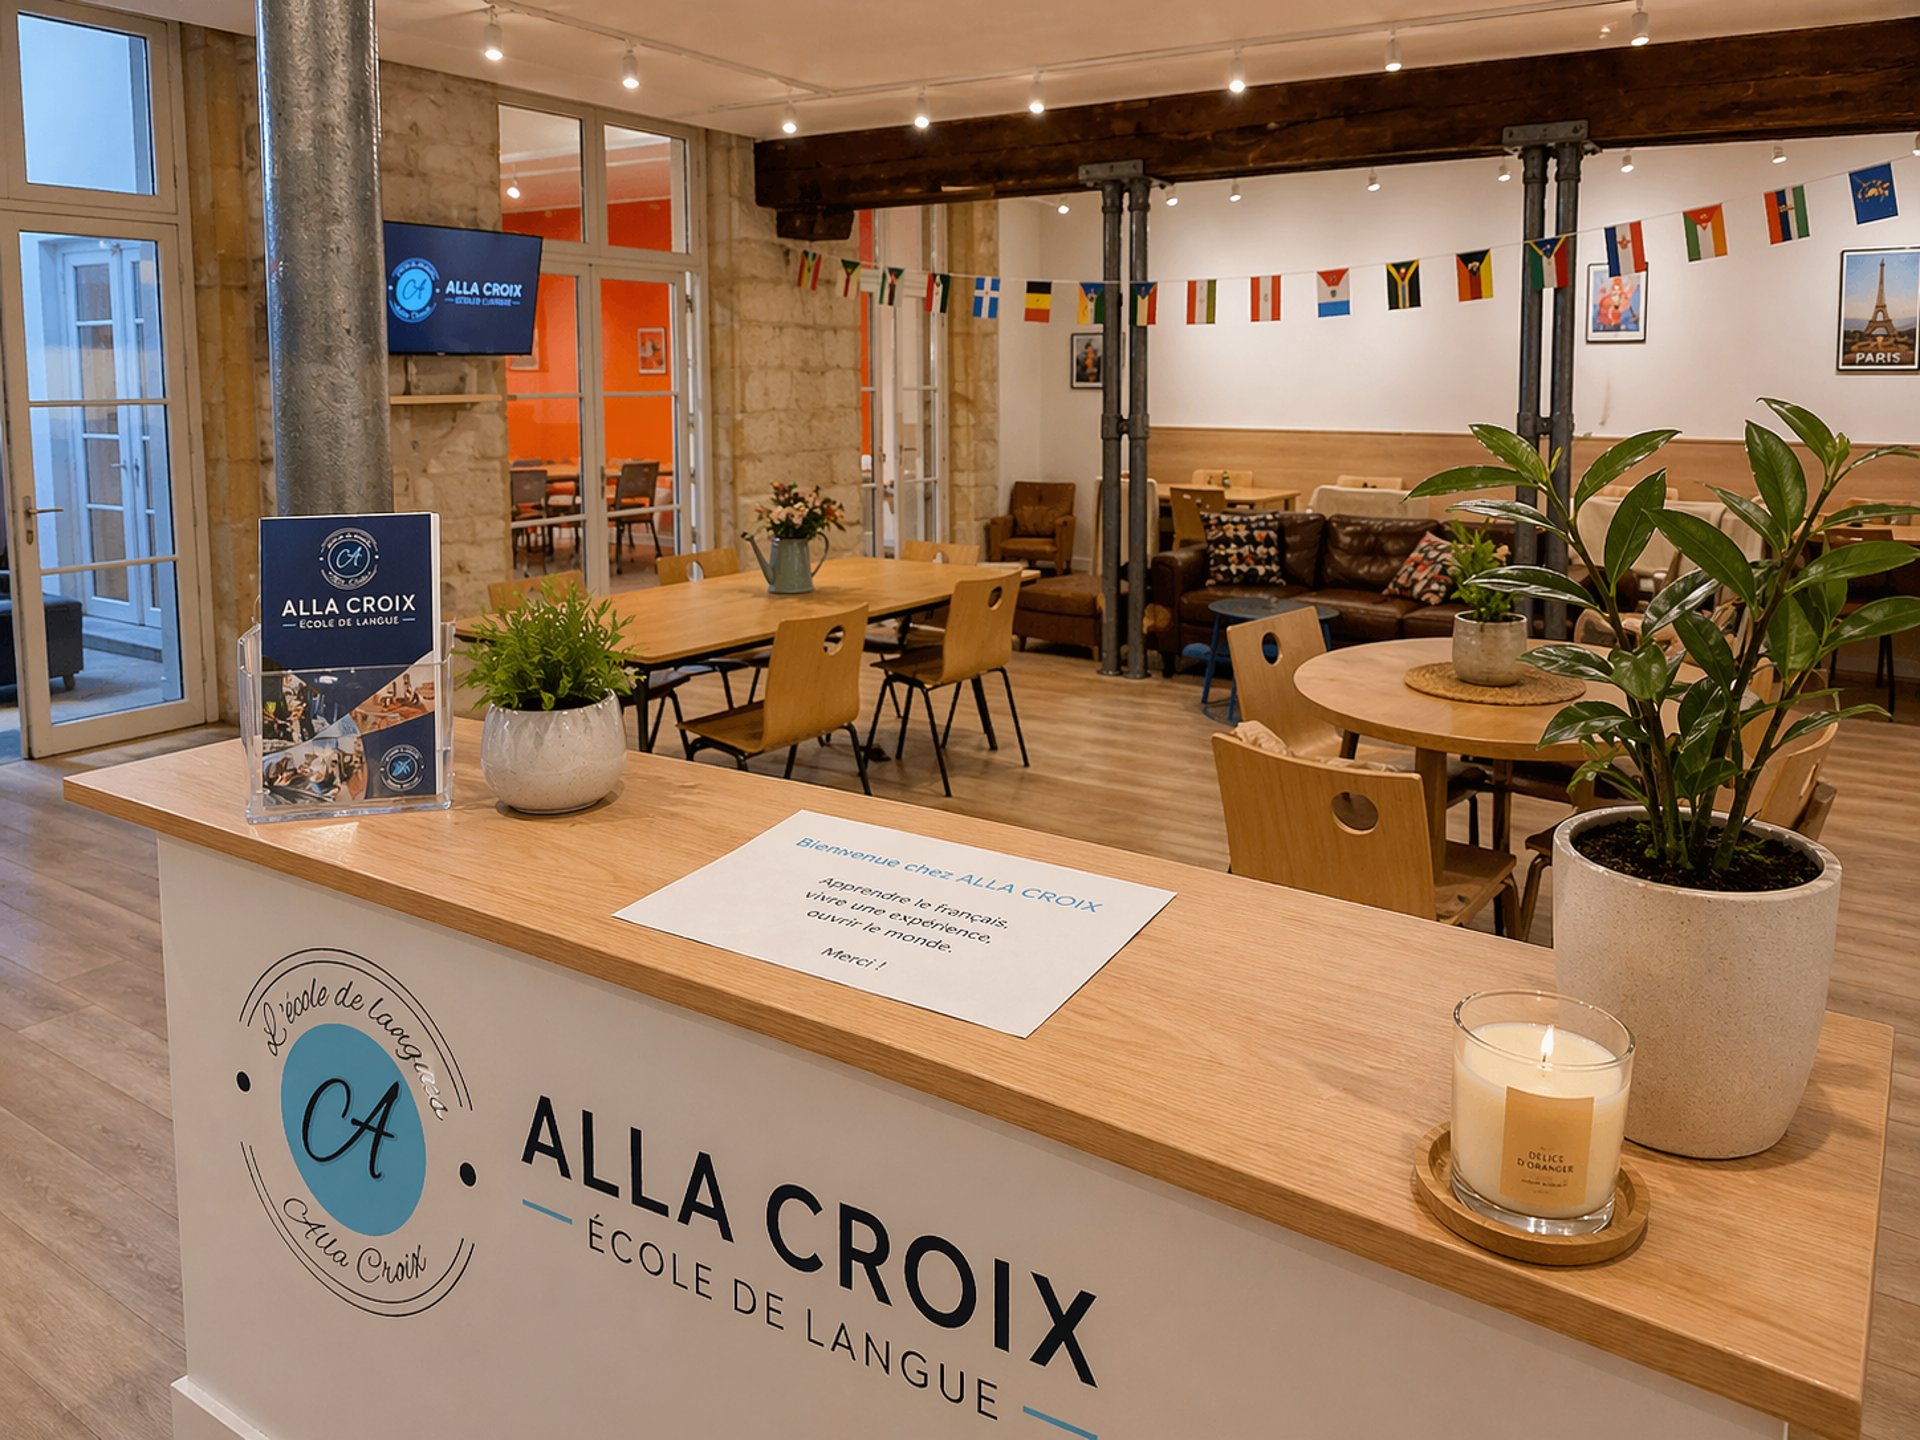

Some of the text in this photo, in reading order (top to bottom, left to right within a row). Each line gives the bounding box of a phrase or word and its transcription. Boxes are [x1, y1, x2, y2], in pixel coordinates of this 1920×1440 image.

[445, 280, 522, 298] ALLA CROIX
[1855, 352, 1901, 363] PARIS
[281, 594, 416, 617] ALLA CROIX
[338, 618, 352, 627] DE
[356, 616, 400, 626] LANGUE
[818, 877, 911, 904] Apprendre
[913, 898, 932, 909] le
[904, 863, 954, 880] chez
[955, 874, 1014, 894] ALLA
[1021, 888, 1103, 912] CROIX
[806, 891, 847, 906] vivre
[850, 903, 886, 916] une
[807, 910, 951, 953] ouvrir le monde.
[821, 947, 877, 967] Merci
[334, 981, 365, 1011] de
[302, 1078, 399, 1179] CA
[521, 1095, 1098, 1389] ALLA CROIX
[357, 1244, 427, 1284] Croix
[588, 1214, 998, 1421] ÉCOLE DE LANGUE
